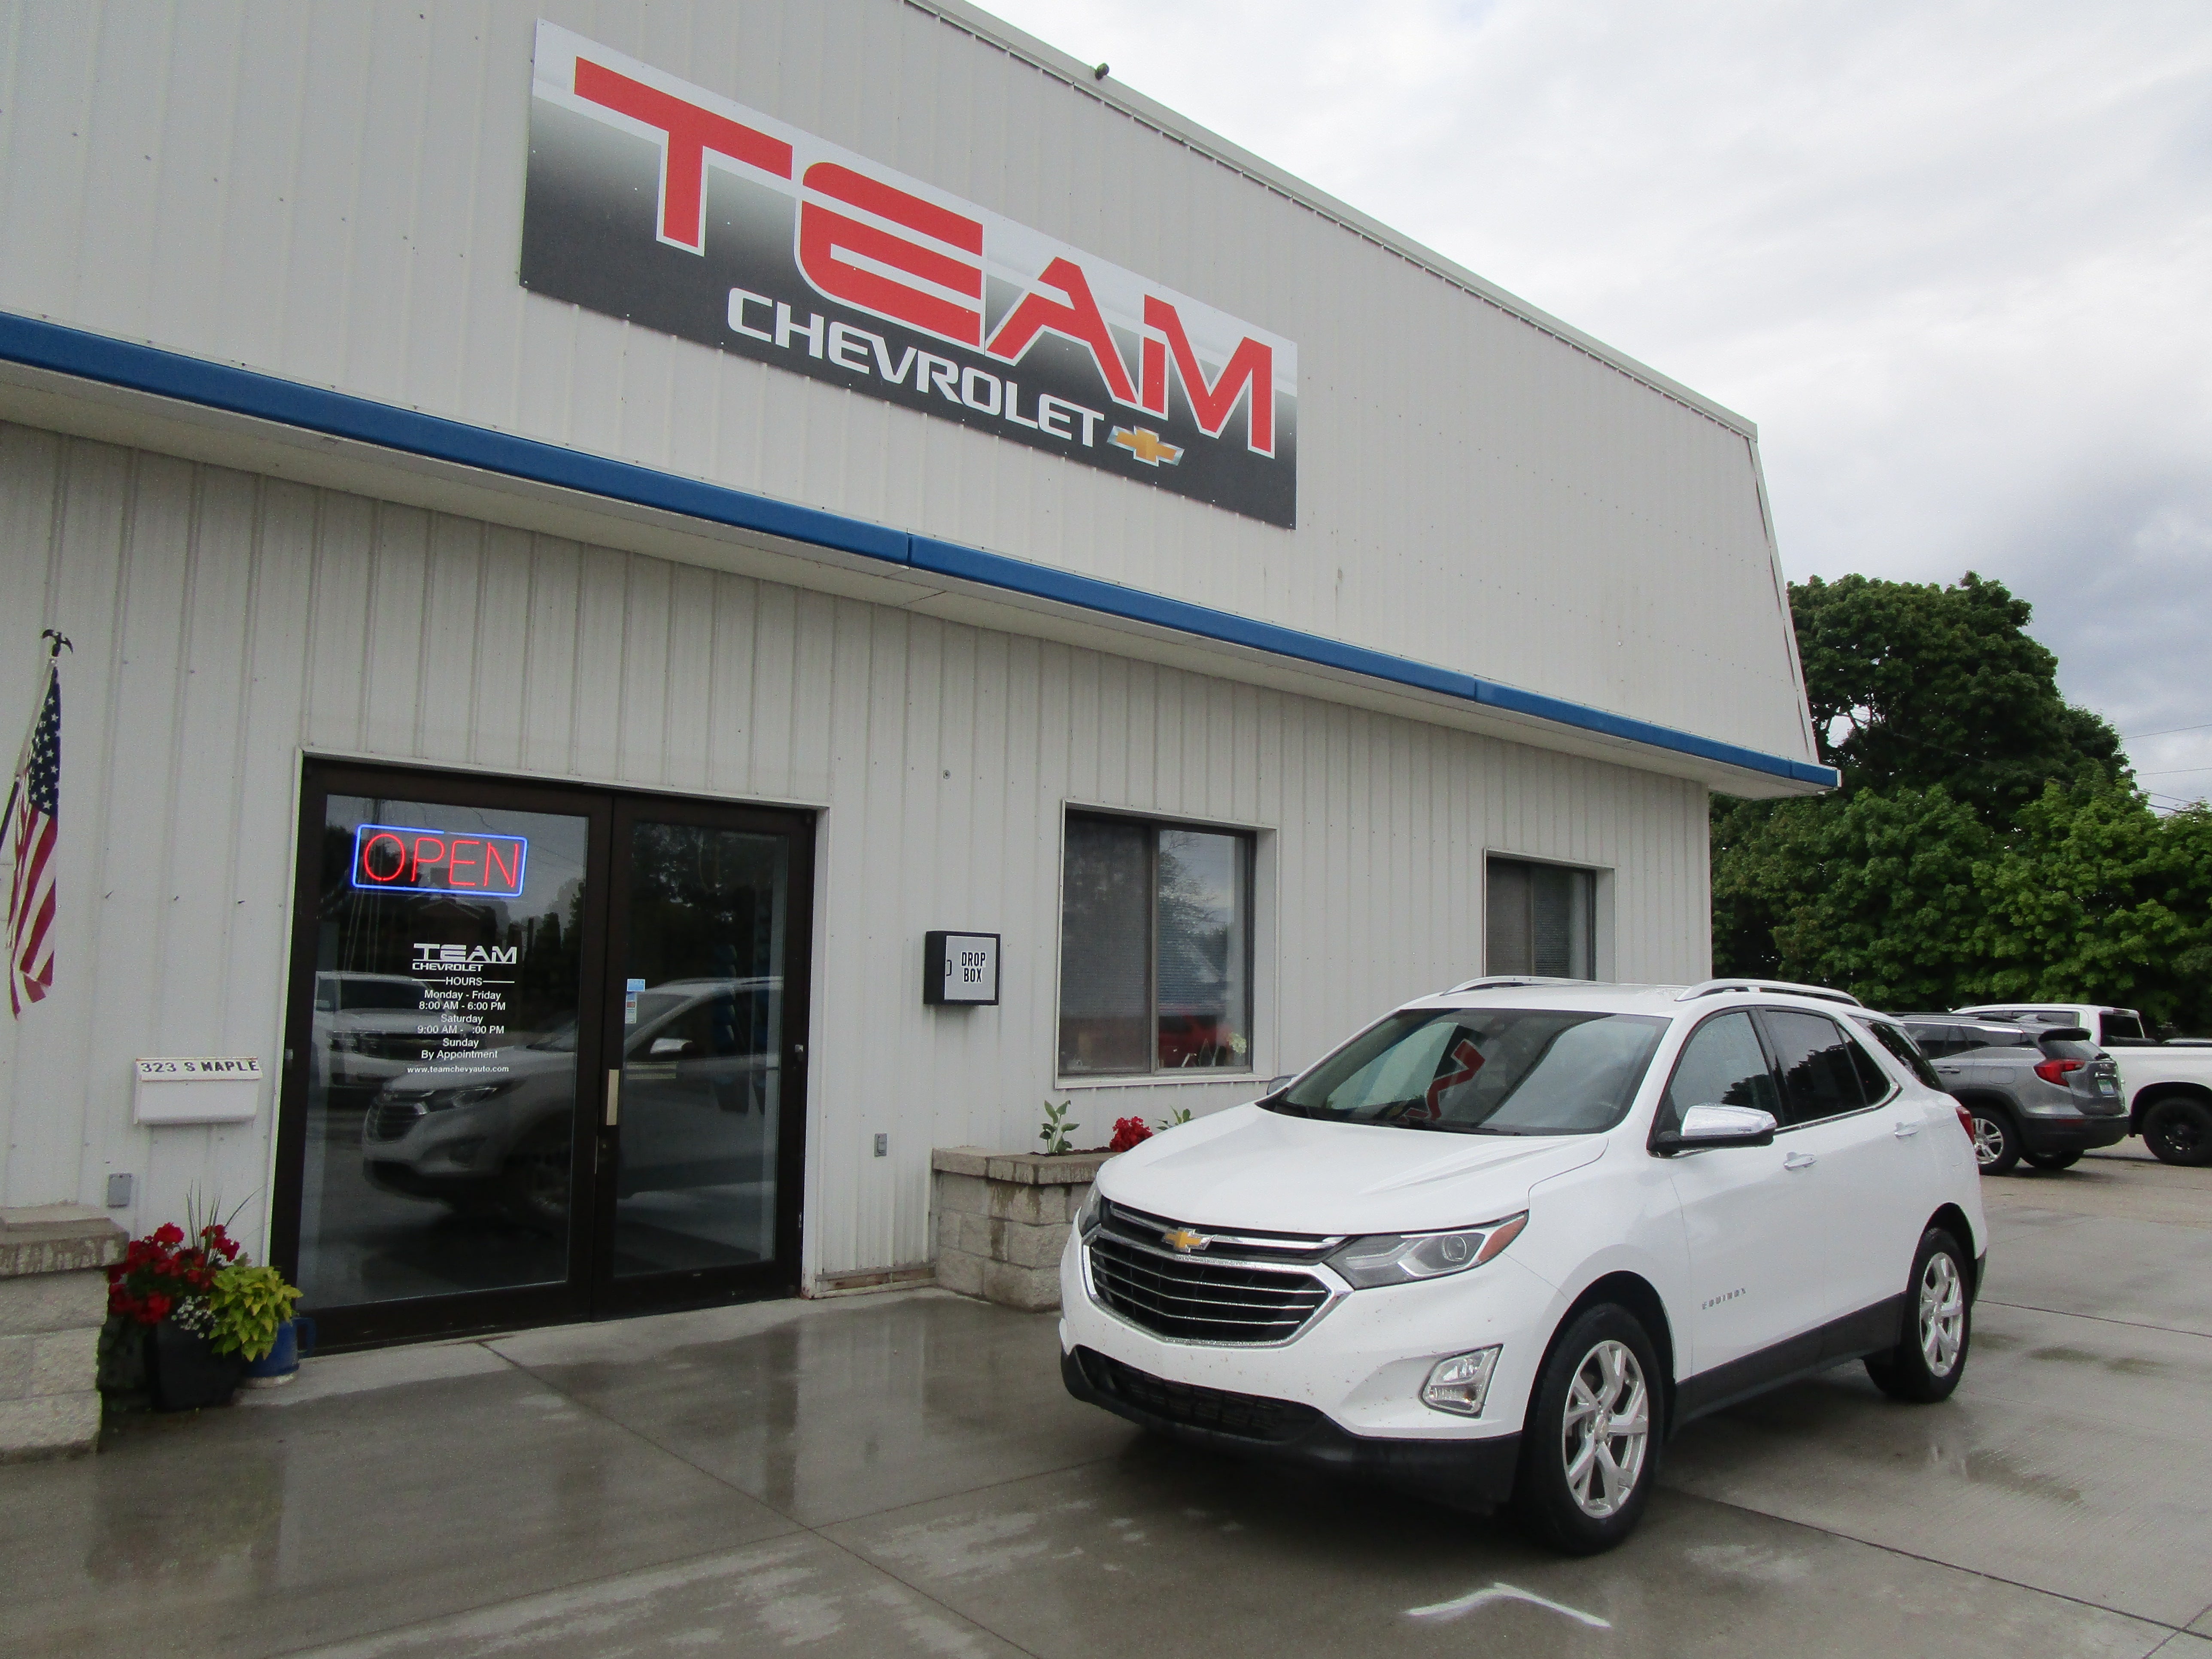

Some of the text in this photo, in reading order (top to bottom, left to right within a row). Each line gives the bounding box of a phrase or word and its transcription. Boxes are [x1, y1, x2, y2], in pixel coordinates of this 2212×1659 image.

[574, 56, 1273, 456] TEAM
[727, 287, 1105, 448] CHEVROLET
[363, 833, 520, 888] OPEN
[413, 943, 517, 963] TEAM
[961, 952, 986, 966] DROP
[412, 962, 483, 971] CHEVROLET
[963, 968, 982, 982] BOX
[445, 977, 483, 986] HOURS
[424, 990, 463, 1001] Monday
[472, 991, 501, 1001] Friday
[419, 1001, 440, 1010] 8:00
[443, 1001, 459, 1010] AM
[468, 1002, 488, 1010] 6:00
[491, 1002, 506, 1010] PM
[441, 1014, 483, 1025] Saturday
[417, 1025, 439, 1034] 9:00
[441, 1025, 457, 1034] AM
[489, 1026, 504, 1034] PM
[443, 1038, 479, 1049] Sunday
[421, 1050, 498, 1060] By Appointment
[140, 1061, 260, 1073] 323 S MAPLE
